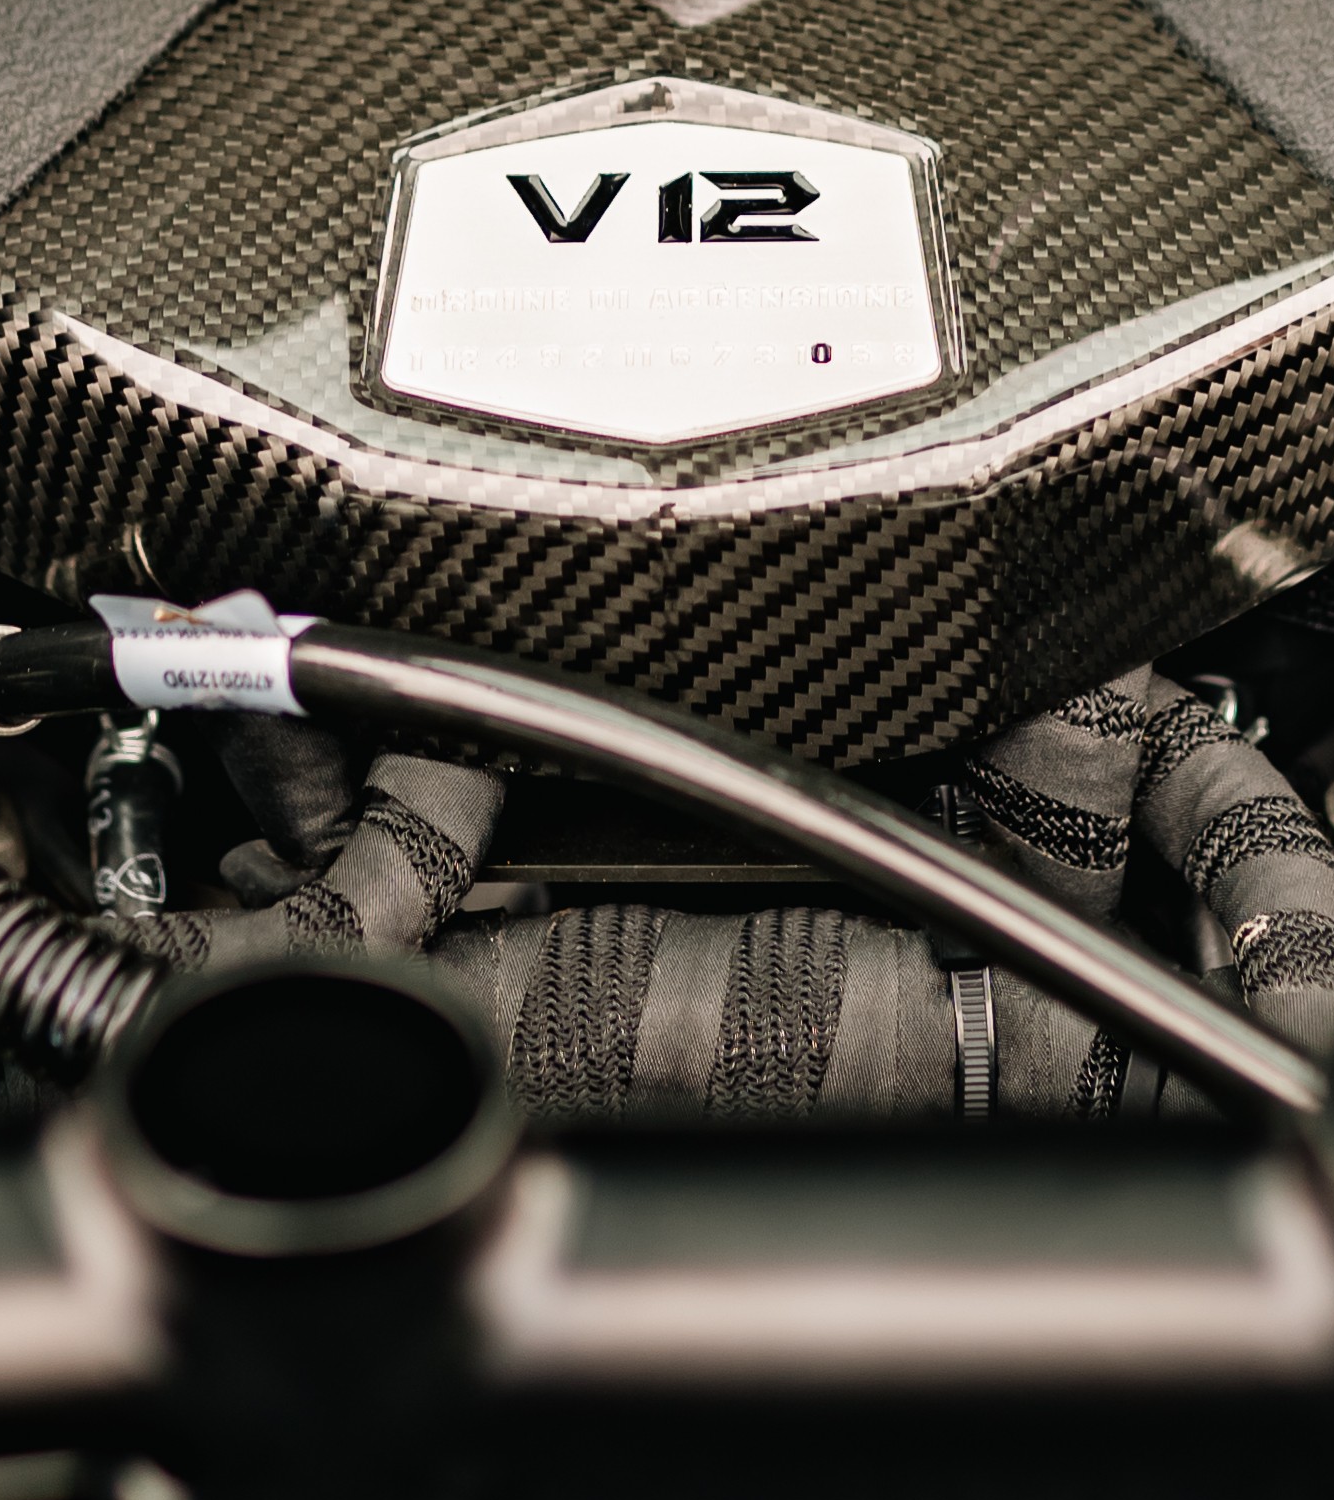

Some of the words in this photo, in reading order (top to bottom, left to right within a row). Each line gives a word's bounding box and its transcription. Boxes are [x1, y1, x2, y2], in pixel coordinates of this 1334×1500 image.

[505, 170, 821, 243] V12
[410, 287, 571, 313] ORDINE
[588, 287, 630, 312] DI
[648, 286, 915, 313] ACCENSIONE
[410, 345, 424, 372] 1
[443, 345, 482, 372] 12
[494, 345, 521, 370] 4
[540, 345, 564, 369] 9
[582, 345, 605, 370] 2
[623, 344, 653, 369] 11
[669, 344, 693, 368] 6
[712, 343, 737, 368] 7
[754, 344, 777, 368] 3
[795, 341, 833, 367] 10
[851, 343, 873, 366] 5
[892, 342, 915, 366] 8
